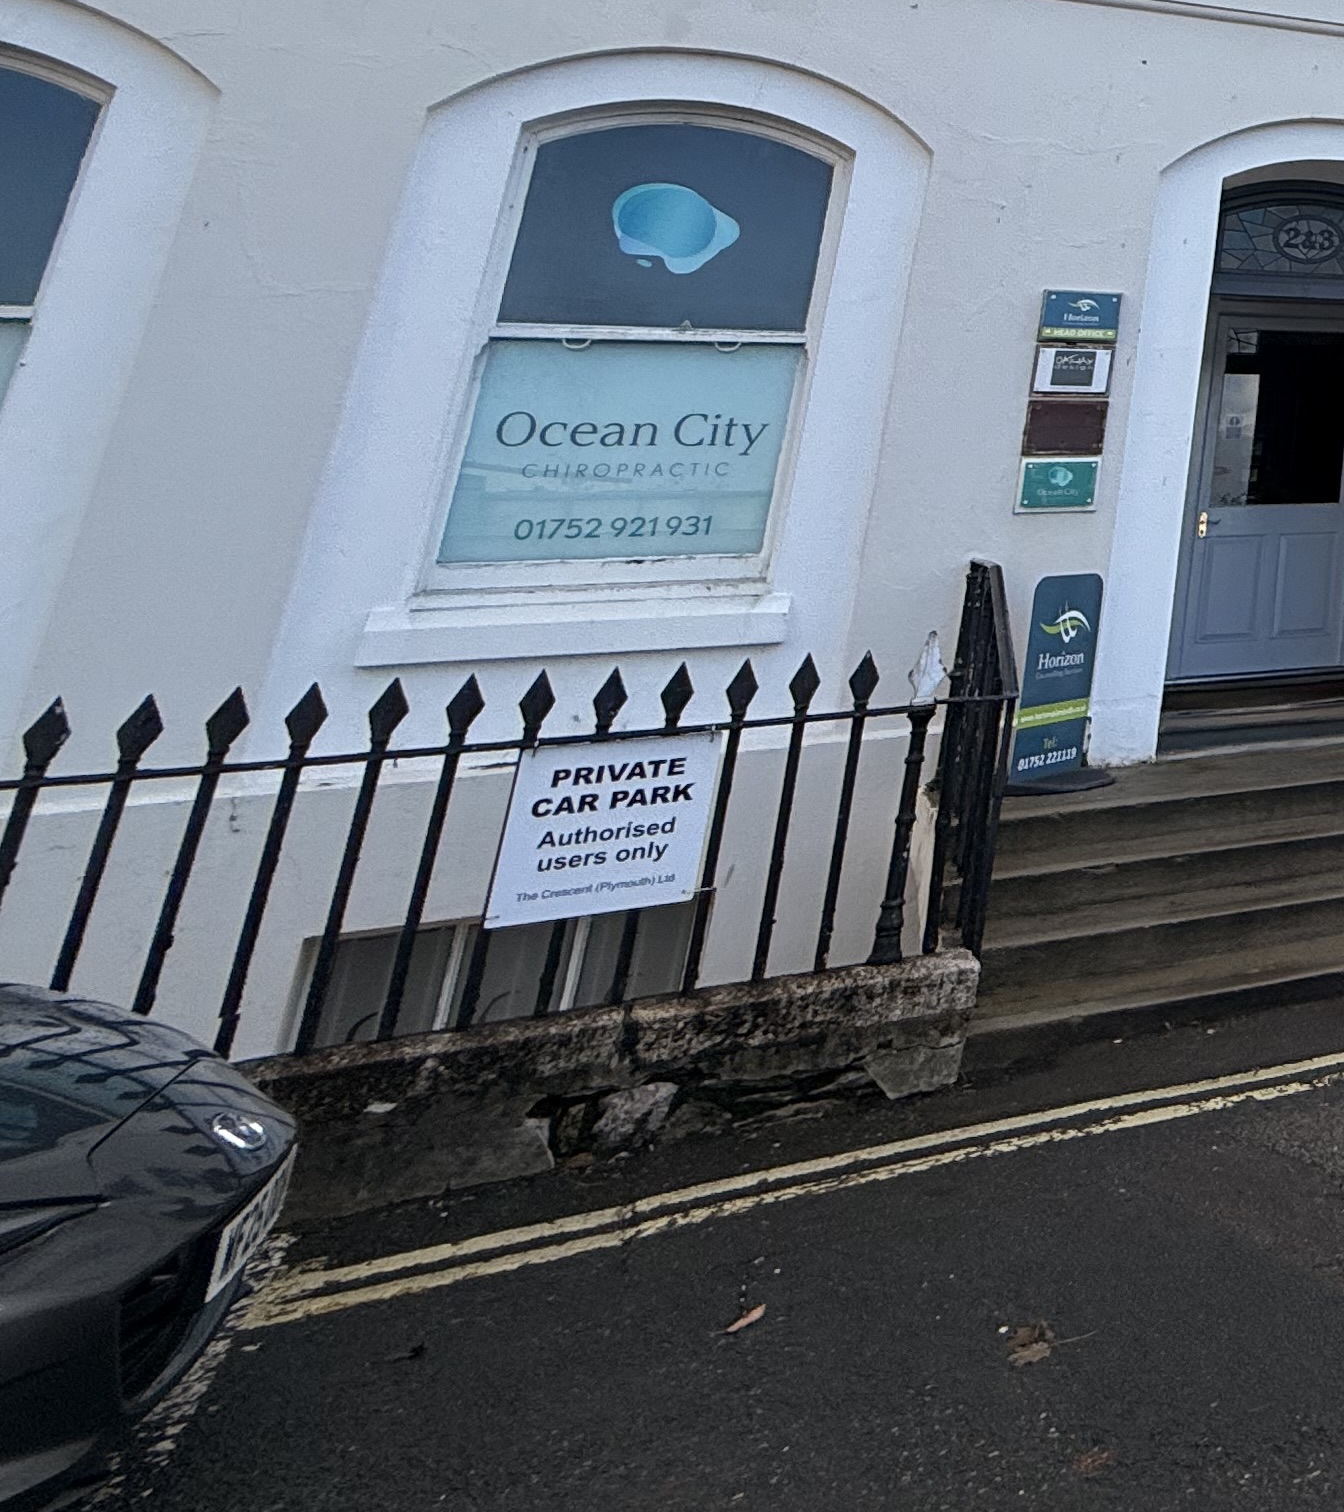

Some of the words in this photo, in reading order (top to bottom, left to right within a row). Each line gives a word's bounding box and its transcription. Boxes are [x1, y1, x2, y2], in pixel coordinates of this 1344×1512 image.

[495, 410, 658, 448] Ocean
[673, 412, 770, 457] City
[521, 461, 731, 479] CHIROPRACTIC
[513, 518, 601, 541] 01752
[609, 517, 660, 539] 921
[665, 515, 713, 537] 931
[1037, 651, 1085, 670] Horizon
[551, 757, 688, 788] PRIVATE
[1016, 754, 1045, 771] 01752
[532, 793, 599, 818] CAR
[609, 782, 697, 810] PARK
[536, 817, 677, 849] Authorised
[537, 850, 607, 872] users
[615, 841, 669, 863] only
[516, 891, 539, 903] The
[540, 883, 594, 900] Crescent
[595, 876, 656, 893] (Plymouth)
[657, 873, 676, 884] Ltd
